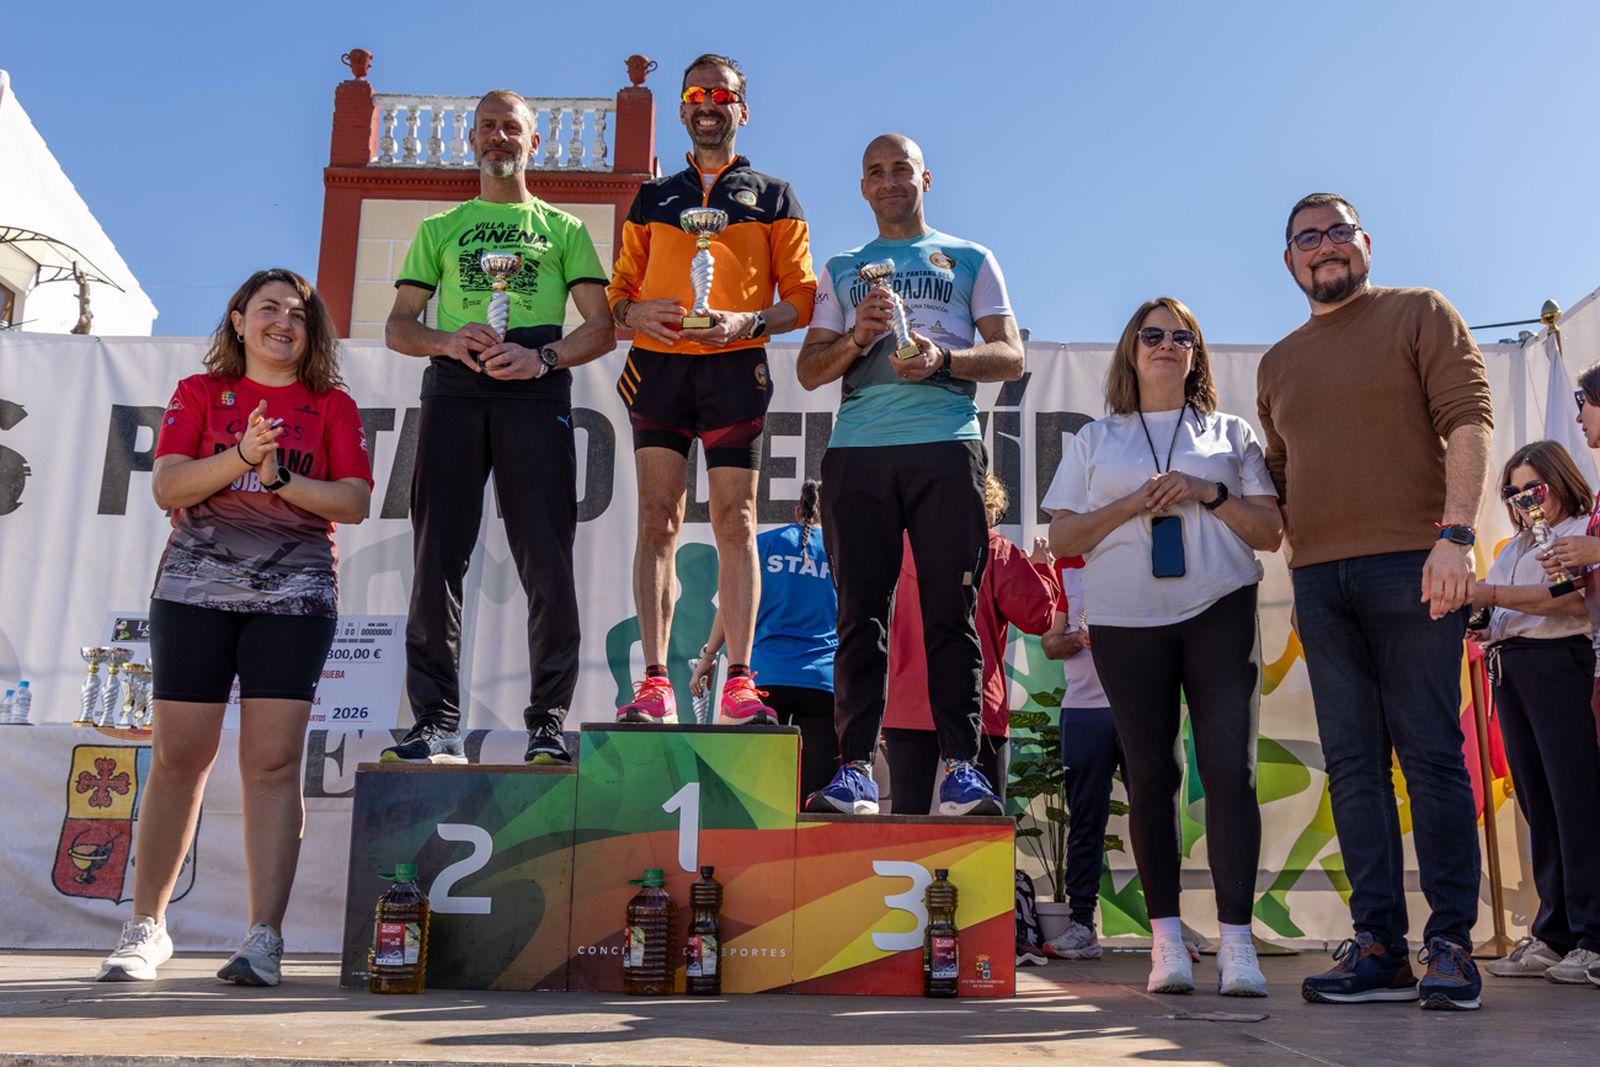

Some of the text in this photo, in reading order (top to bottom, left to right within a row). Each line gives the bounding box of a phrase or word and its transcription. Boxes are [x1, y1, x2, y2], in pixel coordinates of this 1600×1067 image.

[475, 222, 504, 231] VILLA
[458, 229, 548, 247] CANENA
[905, 270, 936, 278] PANTANO
[374, 648, 382, 659] €
[332, 707, 369, 720] 2026
[661, 782, 700, 873] 1
[428, 823, 492, 915] 2
[870, 860, 934, 952] 3
